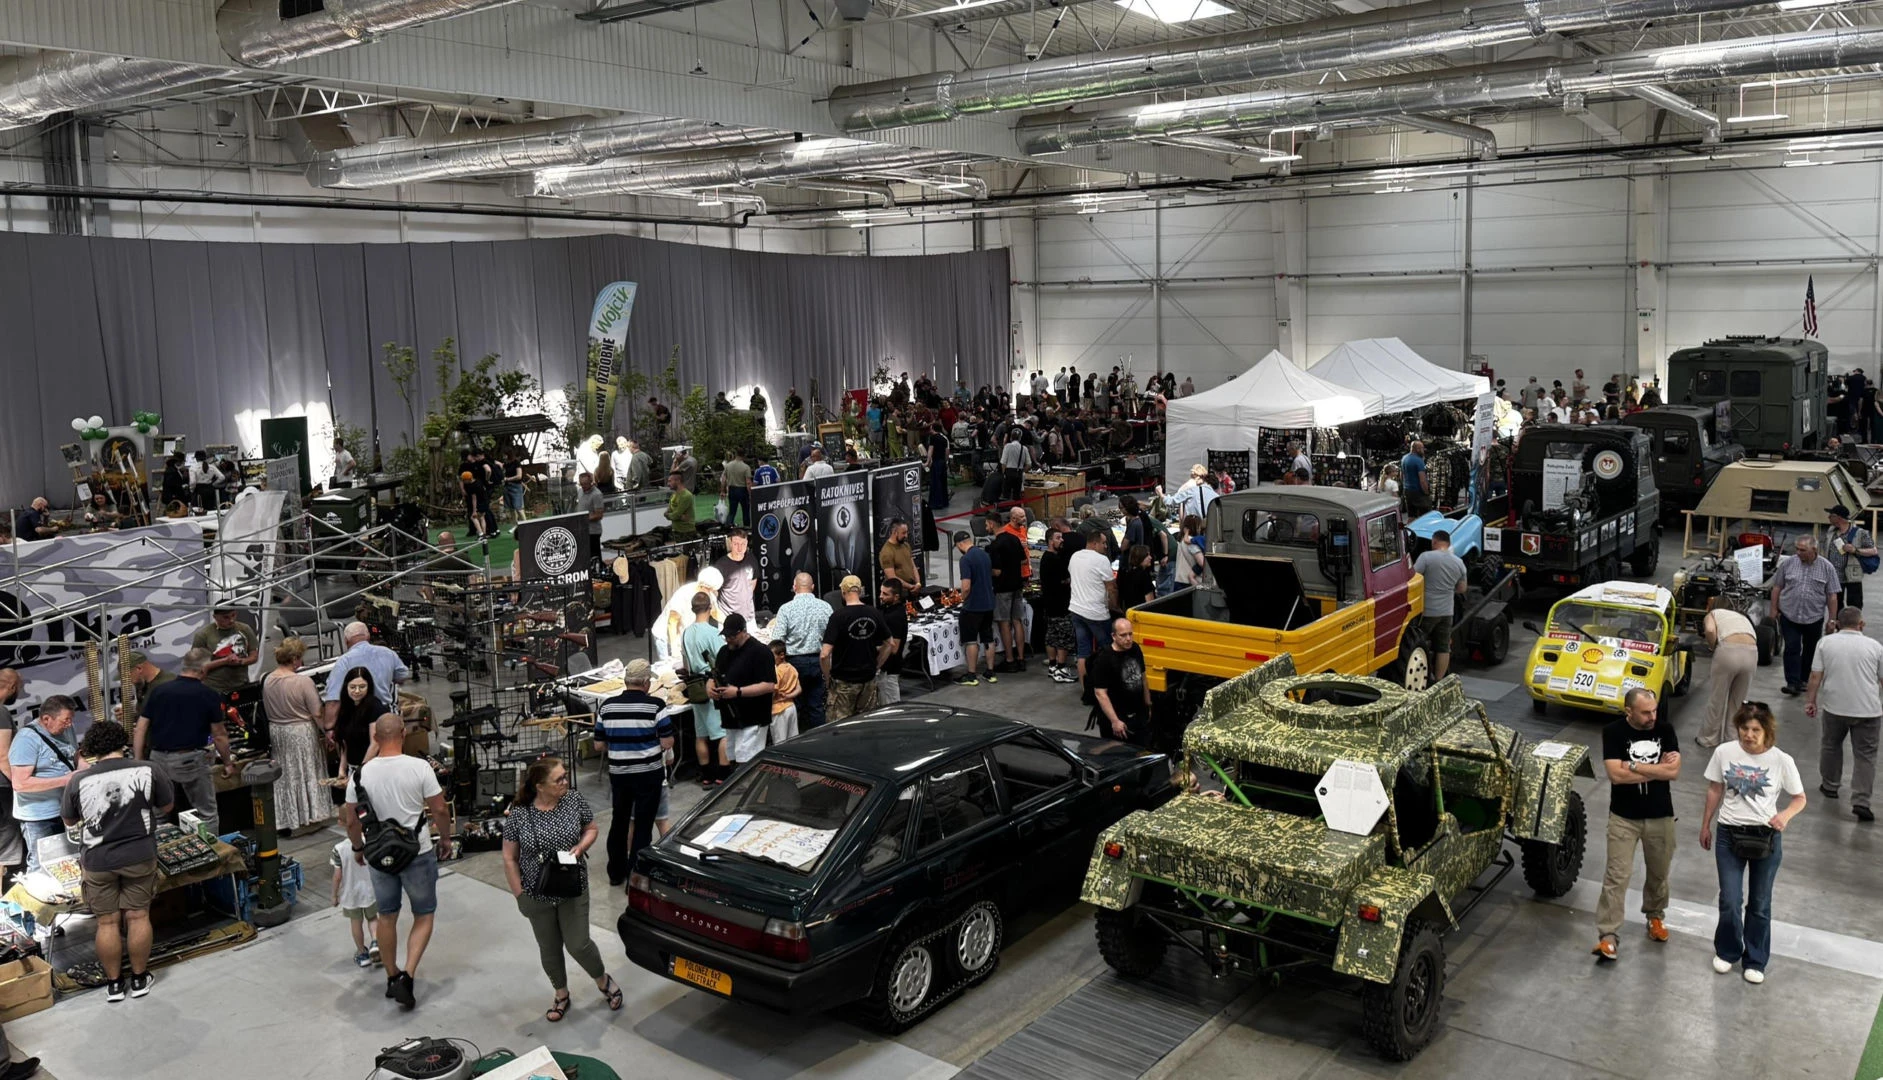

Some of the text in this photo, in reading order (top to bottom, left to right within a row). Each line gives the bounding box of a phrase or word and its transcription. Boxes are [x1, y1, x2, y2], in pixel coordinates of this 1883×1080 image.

[597, 337, 616, 385] OZDOBNE
[761, 475, 771, 485] 10
[821, 482, 864, 500] RATOKNIVES
[757, 502, 767, 512] WE
[1573, 672, 1594, 687] 520
[816, 777, 868, 797] HALFTRACK
[684, 960, 709, 977] POLONEZ
[686, 970, 718, 990] HALFTRACK
